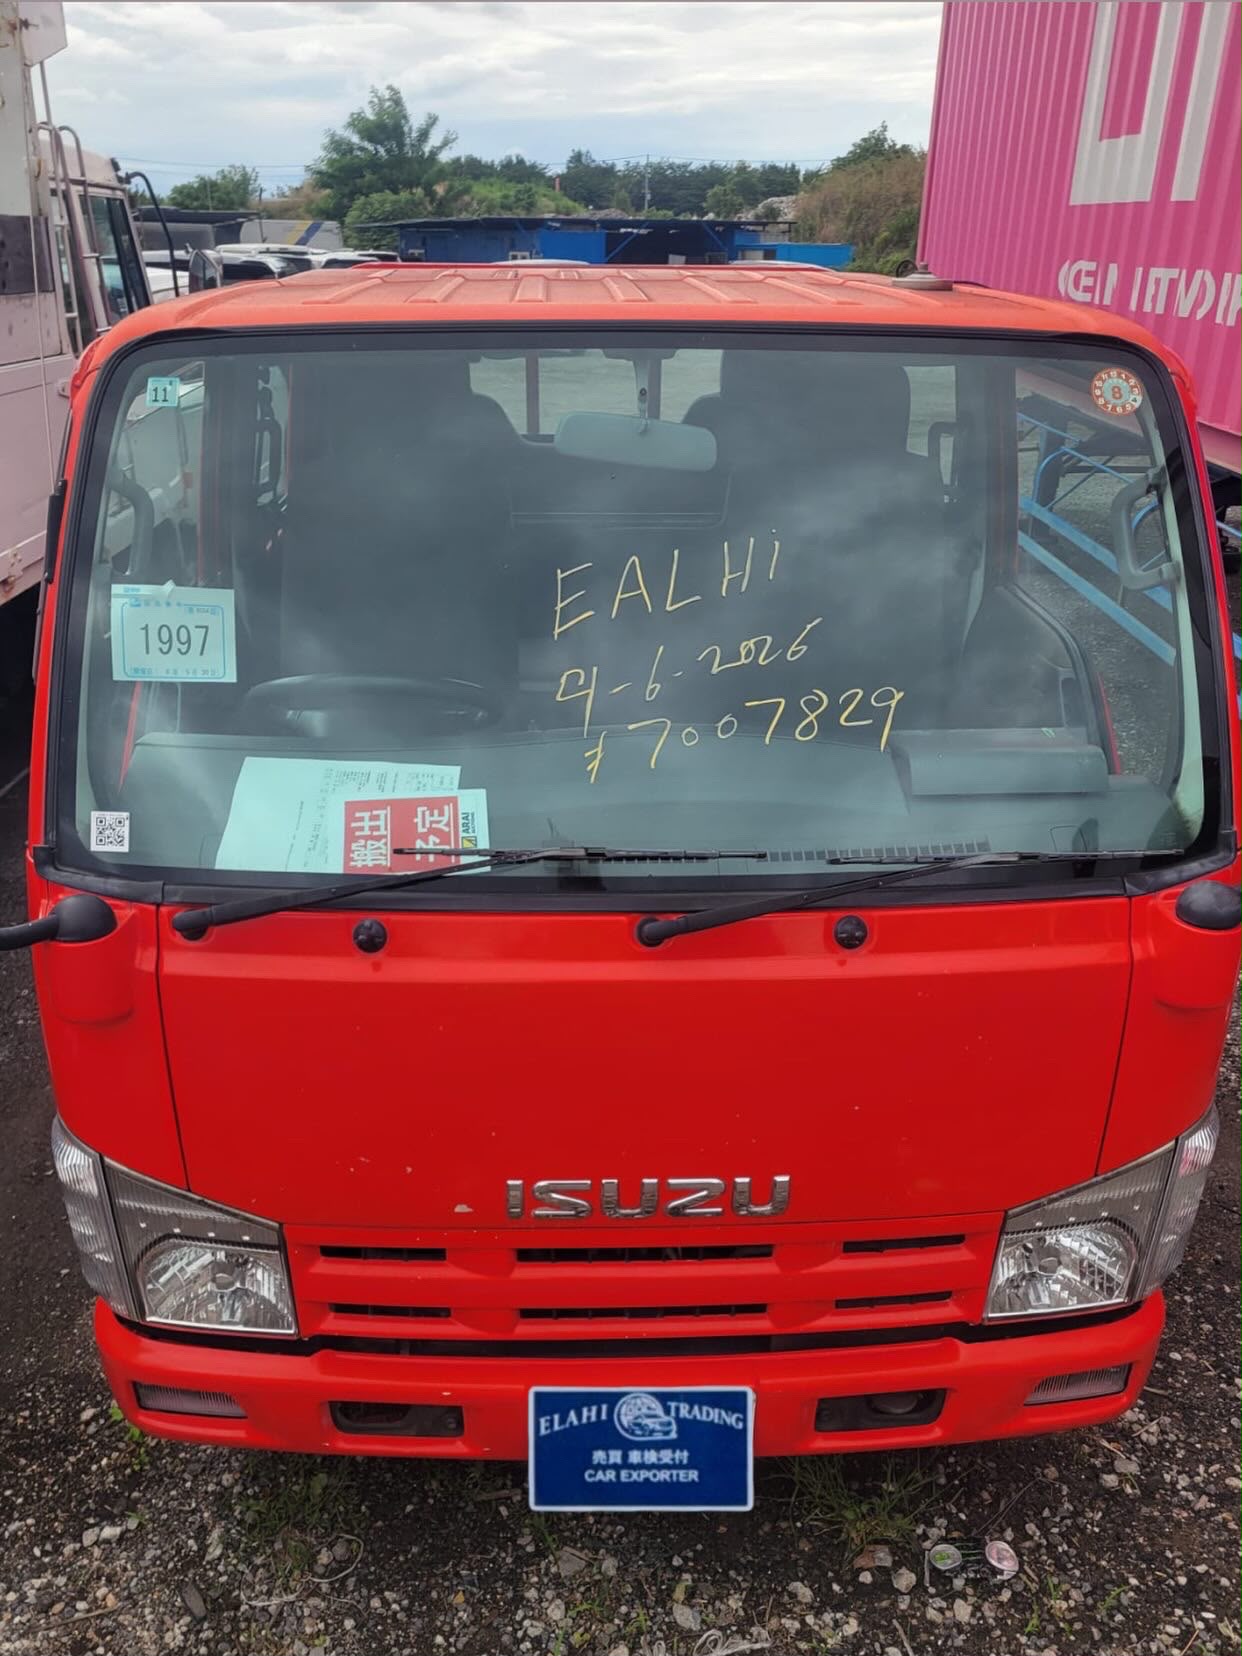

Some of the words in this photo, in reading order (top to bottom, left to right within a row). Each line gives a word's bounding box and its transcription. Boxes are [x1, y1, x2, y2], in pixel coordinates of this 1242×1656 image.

[152, 386, 169, 402] 11
[1112, 385, 1122, 399] 8
[139, 623, 209, 657] 1997
[414, 804, 451, 862] 予定
[461, 812, 470, 834] ARAI
[349, 808, 389, 868] 搬出
[506, 1175, 791, 1218] ISUZU
[538, 1403, 609, 1436] ELAHI
[667, 1401, 744, 1430] TRADING
[592, 1449, 622, 1465] 売買
[628, 1449, 689, 1465] 車検受付
[584, 1469, 616, 1483] CAR
[620, 1469, 699, 1483] EXPORTER
